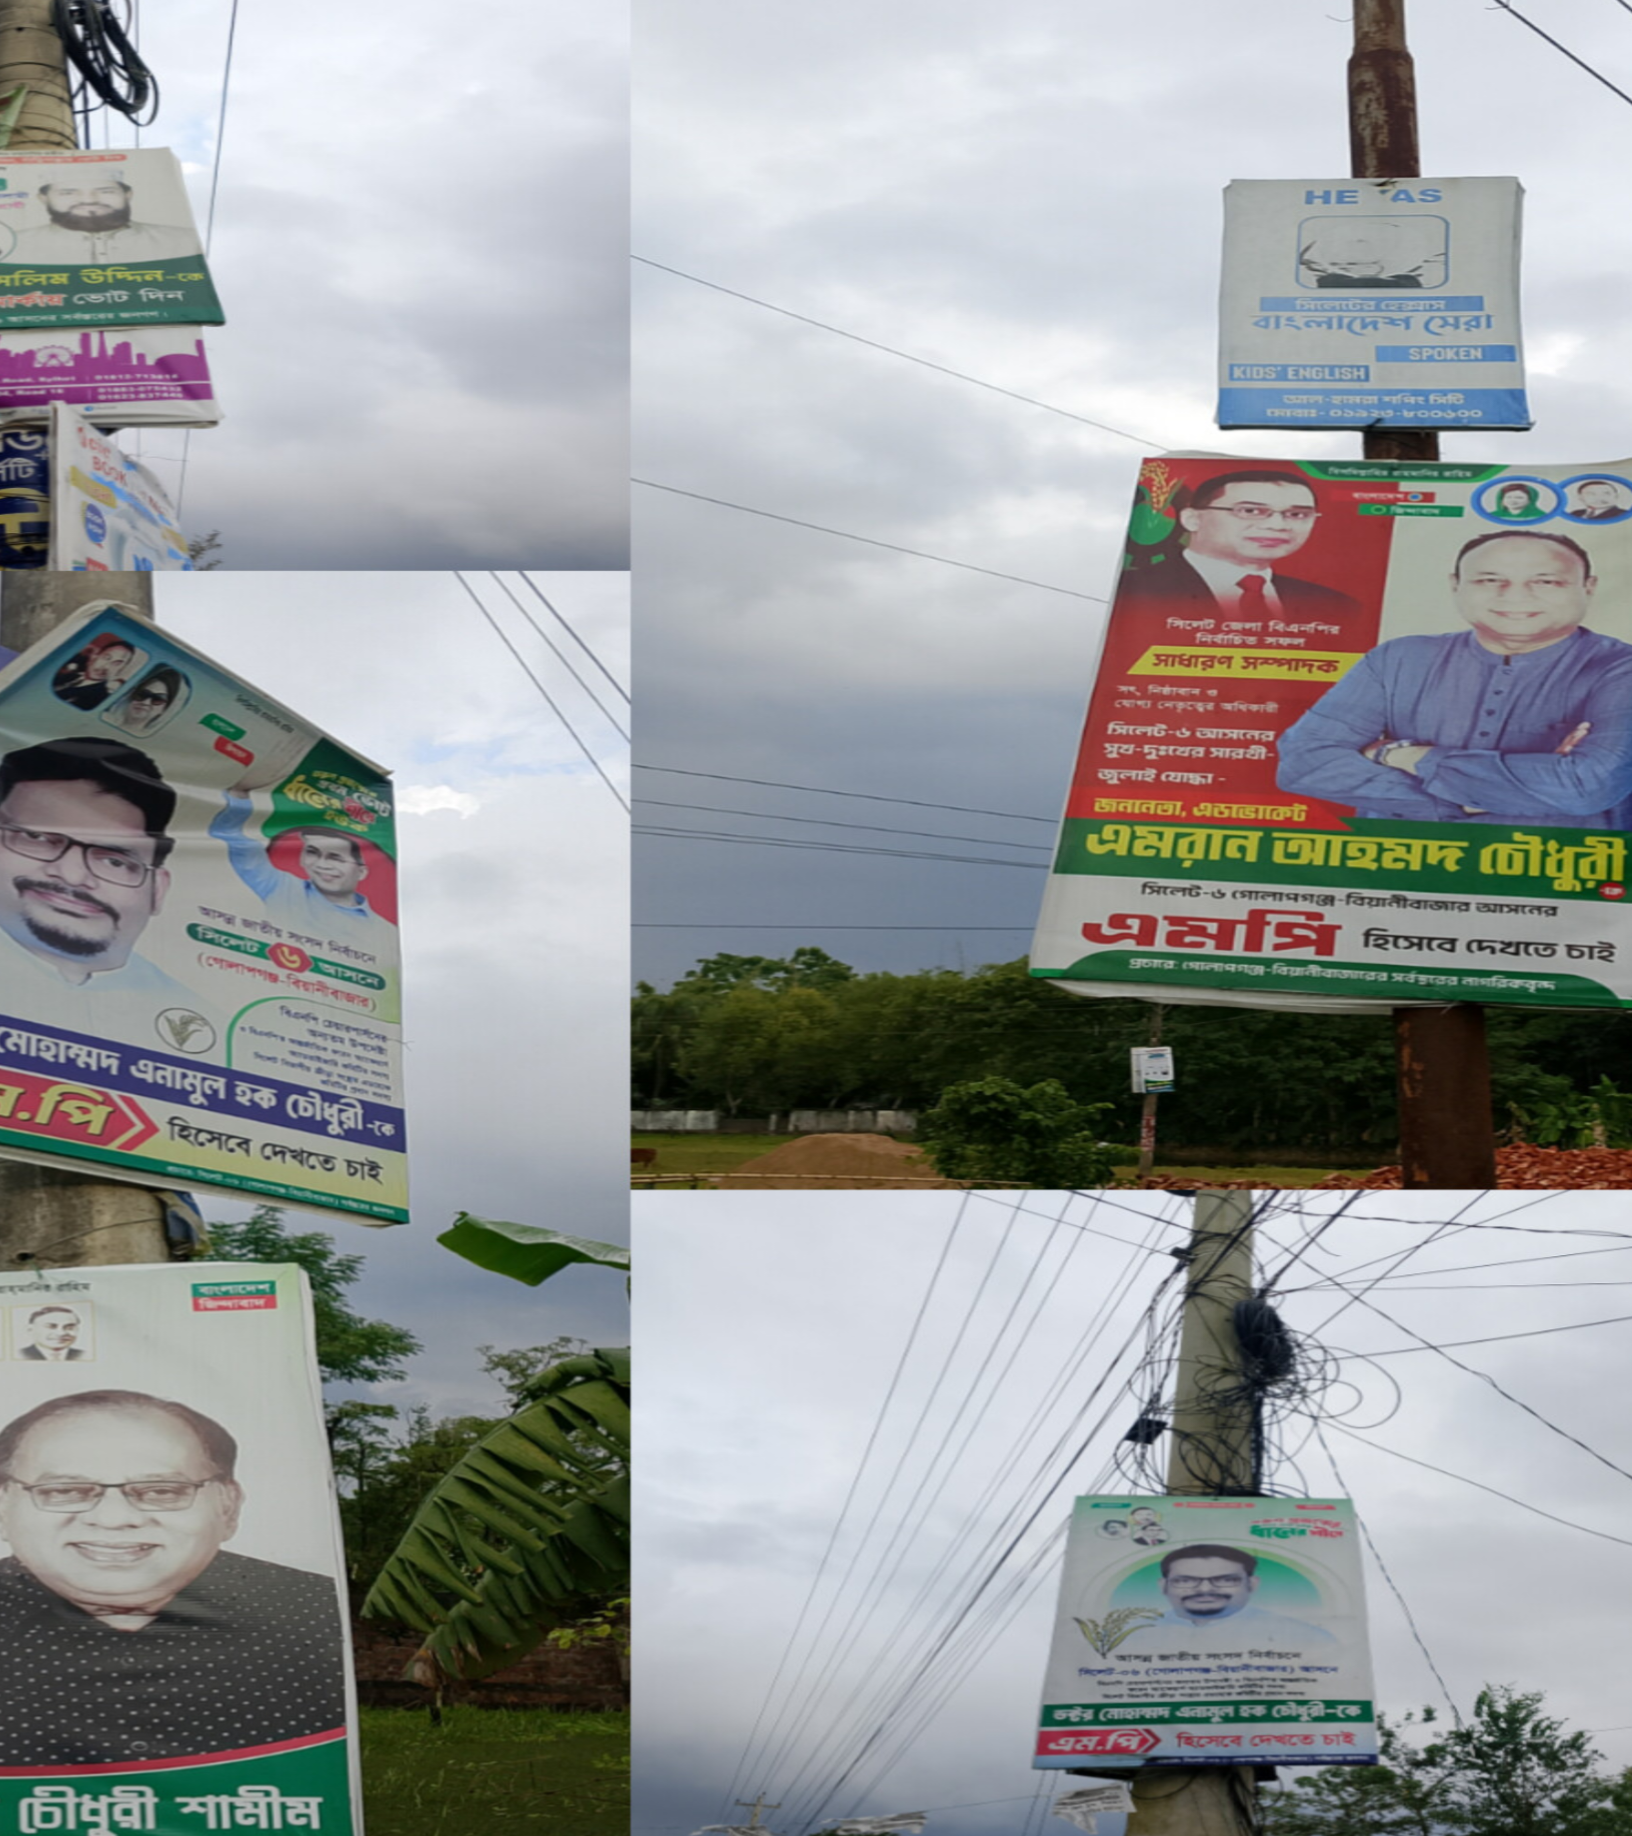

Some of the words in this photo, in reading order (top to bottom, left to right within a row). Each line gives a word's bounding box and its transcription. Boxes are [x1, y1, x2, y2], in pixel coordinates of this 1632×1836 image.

[73, 290, 130, 306] ভোট
[139, 288, 185, 303] দিন
[1250, 315, 1413, 335] বাংলাদেশ
[1423, 315, 1495, 335] সেরা
[1409, 347, 1482, 360] SPOKEN
[1288, 367, 1365, 380] ENGLISH
[1166, 617, 1215, 630] সিলেট
[1222, 621, 1262, 632] জেলা
[1268, 620, 1340, 635] বিএনপির
[1153, 652, 1235, 671] সাধারণ
[1241, 656, 1340, 674] সম্পাদক
[1107, 721, 1191, 739] সিলেট-৬
[1196, 728, 1275, 742] আসনের
[1098, 768, 1156, 785] জুলাই
[1193, 802, 1308, 822] এডভোকেট
[1086, 824, 1263, 868] এমরান
[1272, 832, 1469, 872] আহমদ
[1479, 831, 1628, 892] চৌধুরী
[1141, 882, 1227, 900] সিলেট-৬
[1475, 901, 1559, 918] আসনের
[1081, 908, 1343, 957] এমপি
[1363, 928, 1459, 953] হিসেবে
[1465, 937, 1559, 959] দেখতে
[1565, 941, 1618, 963] চাই
[195, 925, 261, 953] সিলেট
[277, 947, 300, 969] ৬
[129, 1058, 227, 1106] এনামুল
[234, 1081, 278, 1111] হক
[167, 1116, 252, 1157] হিসেবে
[260, 1141, 338, 1174] দেখতে
[344, 1158, 385, 1185] চাই
[197, 1283, 273, 1296] বাংলাদেশ
[1098, 1705, 1170, 1721] মোহাম্মদ
[1175, 1705, 1235, 1723] এনামুল
[1239, 1704, 1268, 1718] হক
[1047, 1729, 1144, 1752] এম.পি
[1175, 1731, 1245, 1748] হিসেবে
[1249, 1732, 1316, 1747] দেখতে
[1321, 1731, 1357, 1747] চাই
[18, 1784, 159, 1836] চৌধুরী
[175, 1784, 323, 1830] শামীম
